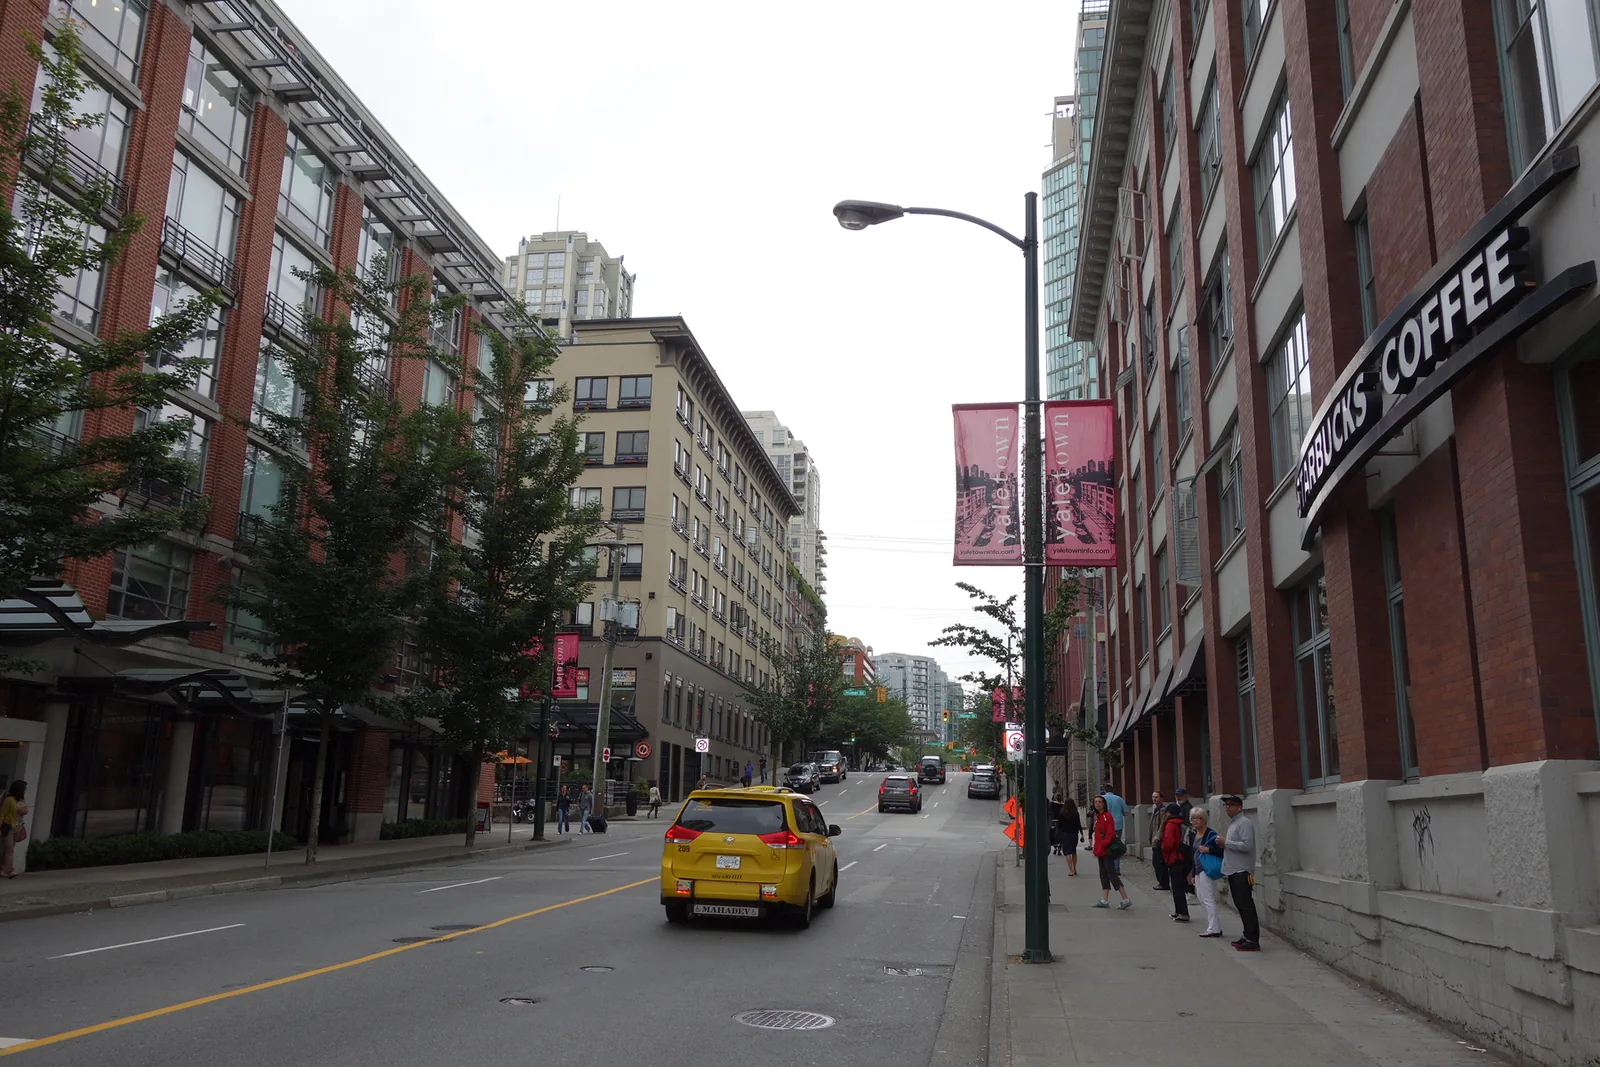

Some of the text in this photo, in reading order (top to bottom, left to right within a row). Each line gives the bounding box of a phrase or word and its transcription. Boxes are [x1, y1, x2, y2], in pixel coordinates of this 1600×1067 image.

[1295, 226, 1517, 519] STARBUCKS COFFEE
[991, 416, 1016, 544] yaletown
[1051, 412, 1076, 541] yaletown
[959, 548, 1015, 556] yaletowninfo.com
[1052, 547, 1110, 555] yaletowninfo.com
[677, 844, 690, 853] 209
[702, 905, 751, 915] MAHADEV
